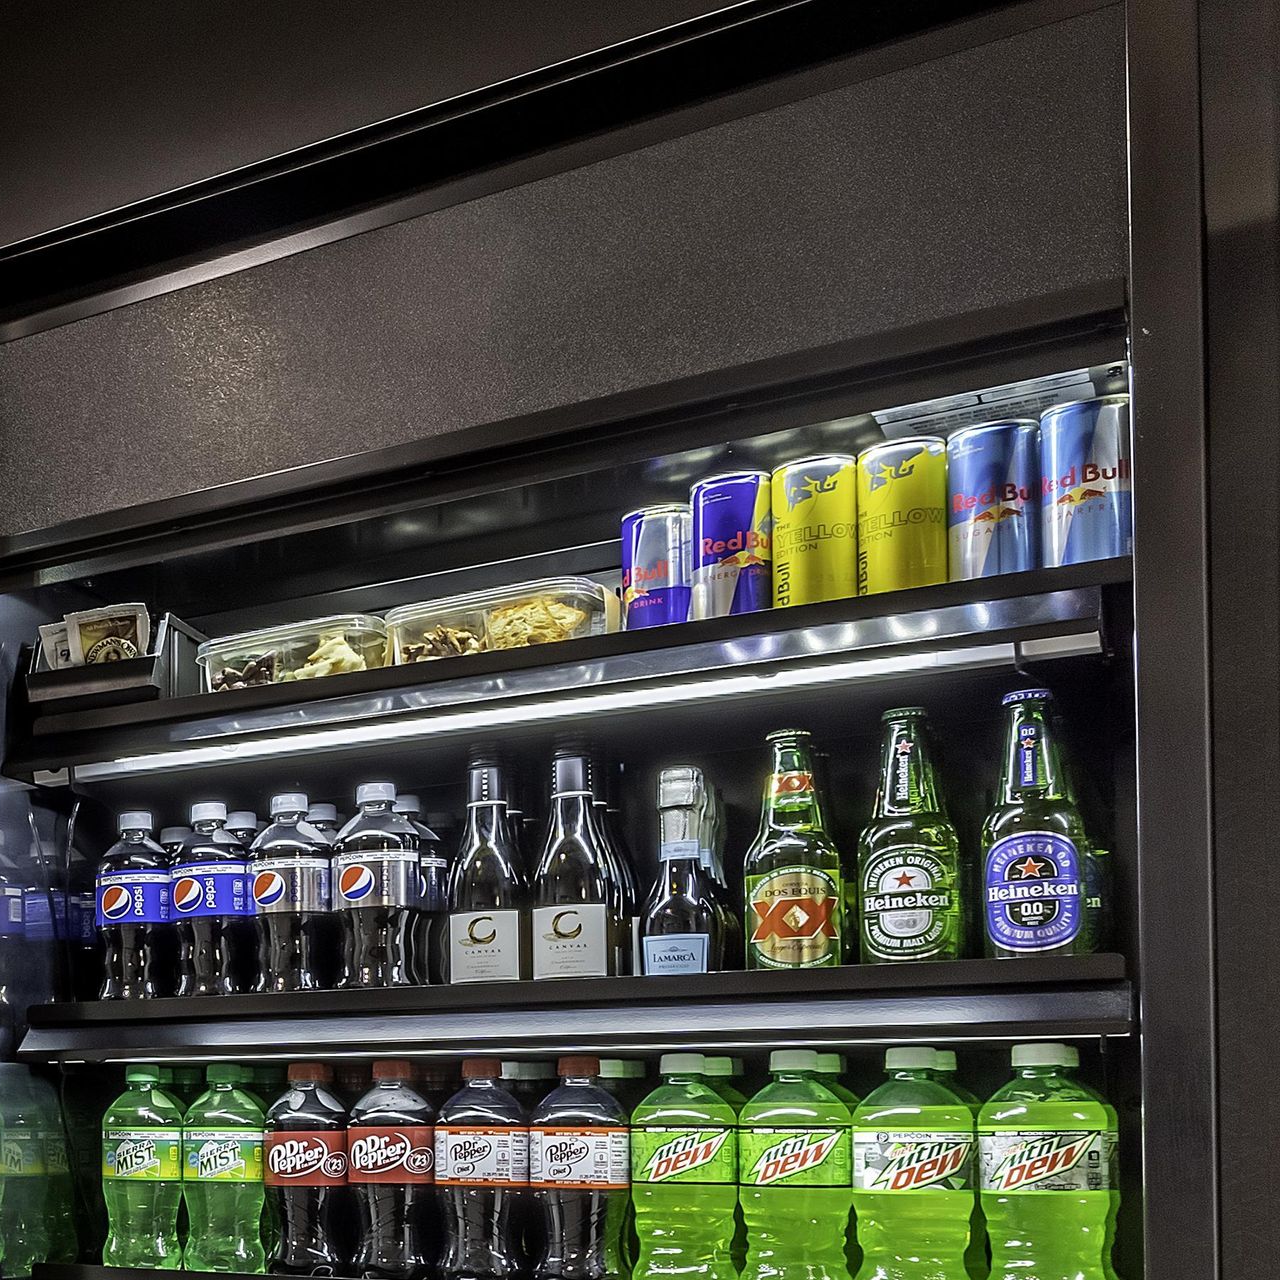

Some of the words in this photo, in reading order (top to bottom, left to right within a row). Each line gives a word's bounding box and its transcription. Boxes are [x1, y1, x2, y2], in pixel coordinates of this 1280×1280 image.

[777, 561, 790, 592] Bull
[633, 597, 663, 609] DRINK
[895, 753, 910, 800] Heineken
[1023, 750, 1033, 783] Heineken
[134, 885, 145, 916] pepsi
[205, 877, 217, 909] pepsi
[764, 889, 789, 898] DOS
[791, 885, 827, 897] EQUIS
[987, 881, 1079, 902] Heineken
[864, 892, 950, 912] Heineken
[116, 1140, 153, 1159] SIERRA
[199, 1140, 237, 1159] SIERRA
[282, 1137, 308, 1155] Dr
[365, 1133, 391, 1152] Dr
[463, 1140, 481, 1152] Dr
[558, 1141, 575, 1153] Dr
[116, 1146, 155, 1175] MIST
[200, 1146, 239, 1174] MIST
[270, 1148, 324, 1173] Pepper
[352, 1143, 407, 1168] Pepper
[452, 1146, 488, 1161] Pepper
[547, 1147, 587, 1163] Pepper
